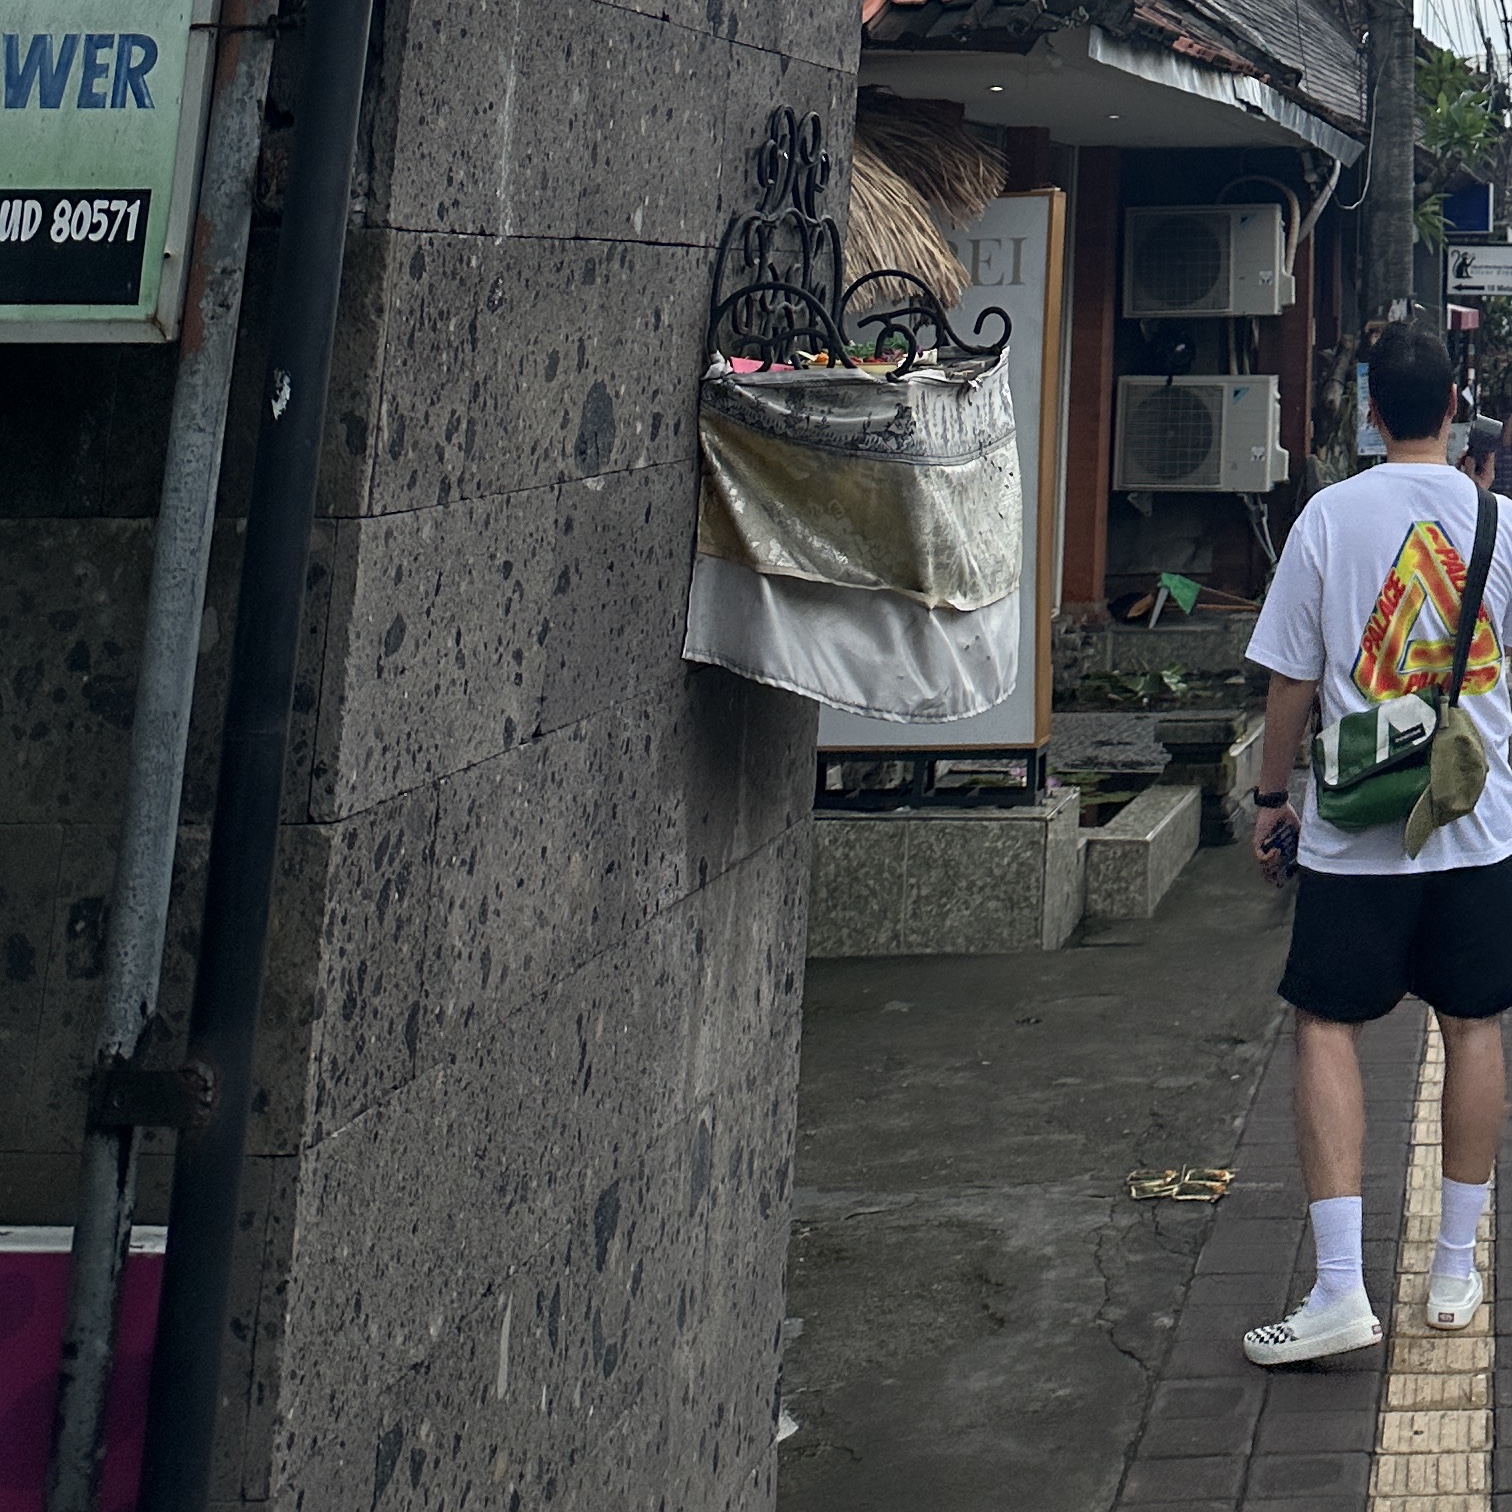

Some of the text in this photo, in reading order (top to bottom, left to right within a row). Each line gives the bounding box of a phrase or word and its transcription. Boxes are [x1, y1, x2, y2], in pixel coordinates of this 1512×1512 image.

[3, 33, 158, 109] WER
[0, 199, 140, 243] UD 80571
[946, 235, 1027, 287] EI
